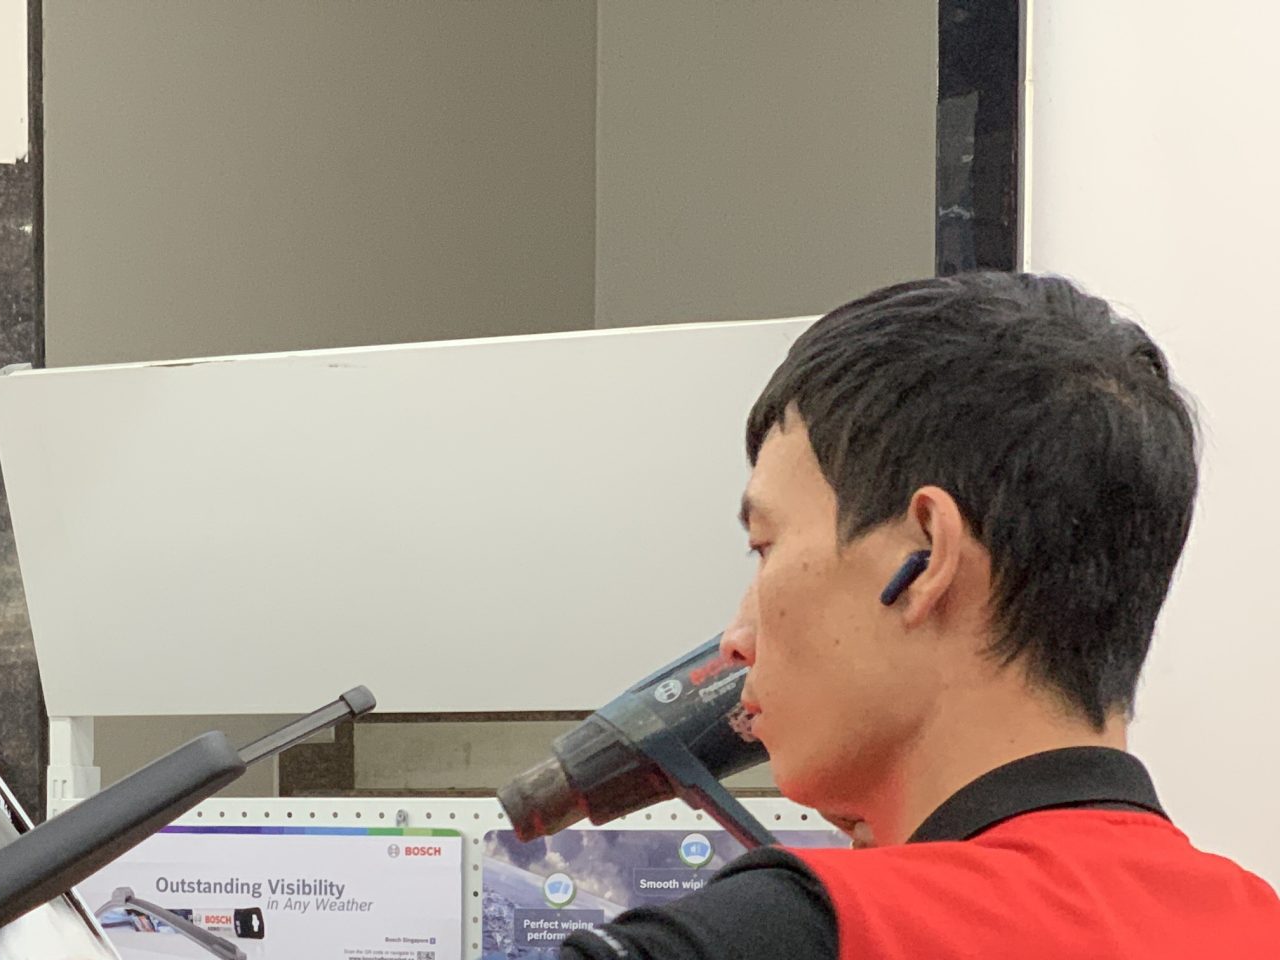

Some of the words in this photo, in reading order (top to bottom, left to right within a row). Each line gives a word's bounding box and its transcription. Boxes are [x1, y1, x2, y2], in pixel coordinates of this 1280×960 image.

[404, 846, 442, 857] BOSCH
[155, 876, 262, 898] Outstanding
[268, 879, 345, 899] Visibility
[640, 879, 679, 889] Smooth
[266, 898, 278, 911] in
[283, 899, 310, 914] Any
[315, 899, 374, 912] Weather
[205, 915, 231, 924] BOSCH
[523, 919, 559, 929] Perfect
[561, 920, 594, 931] wiping
